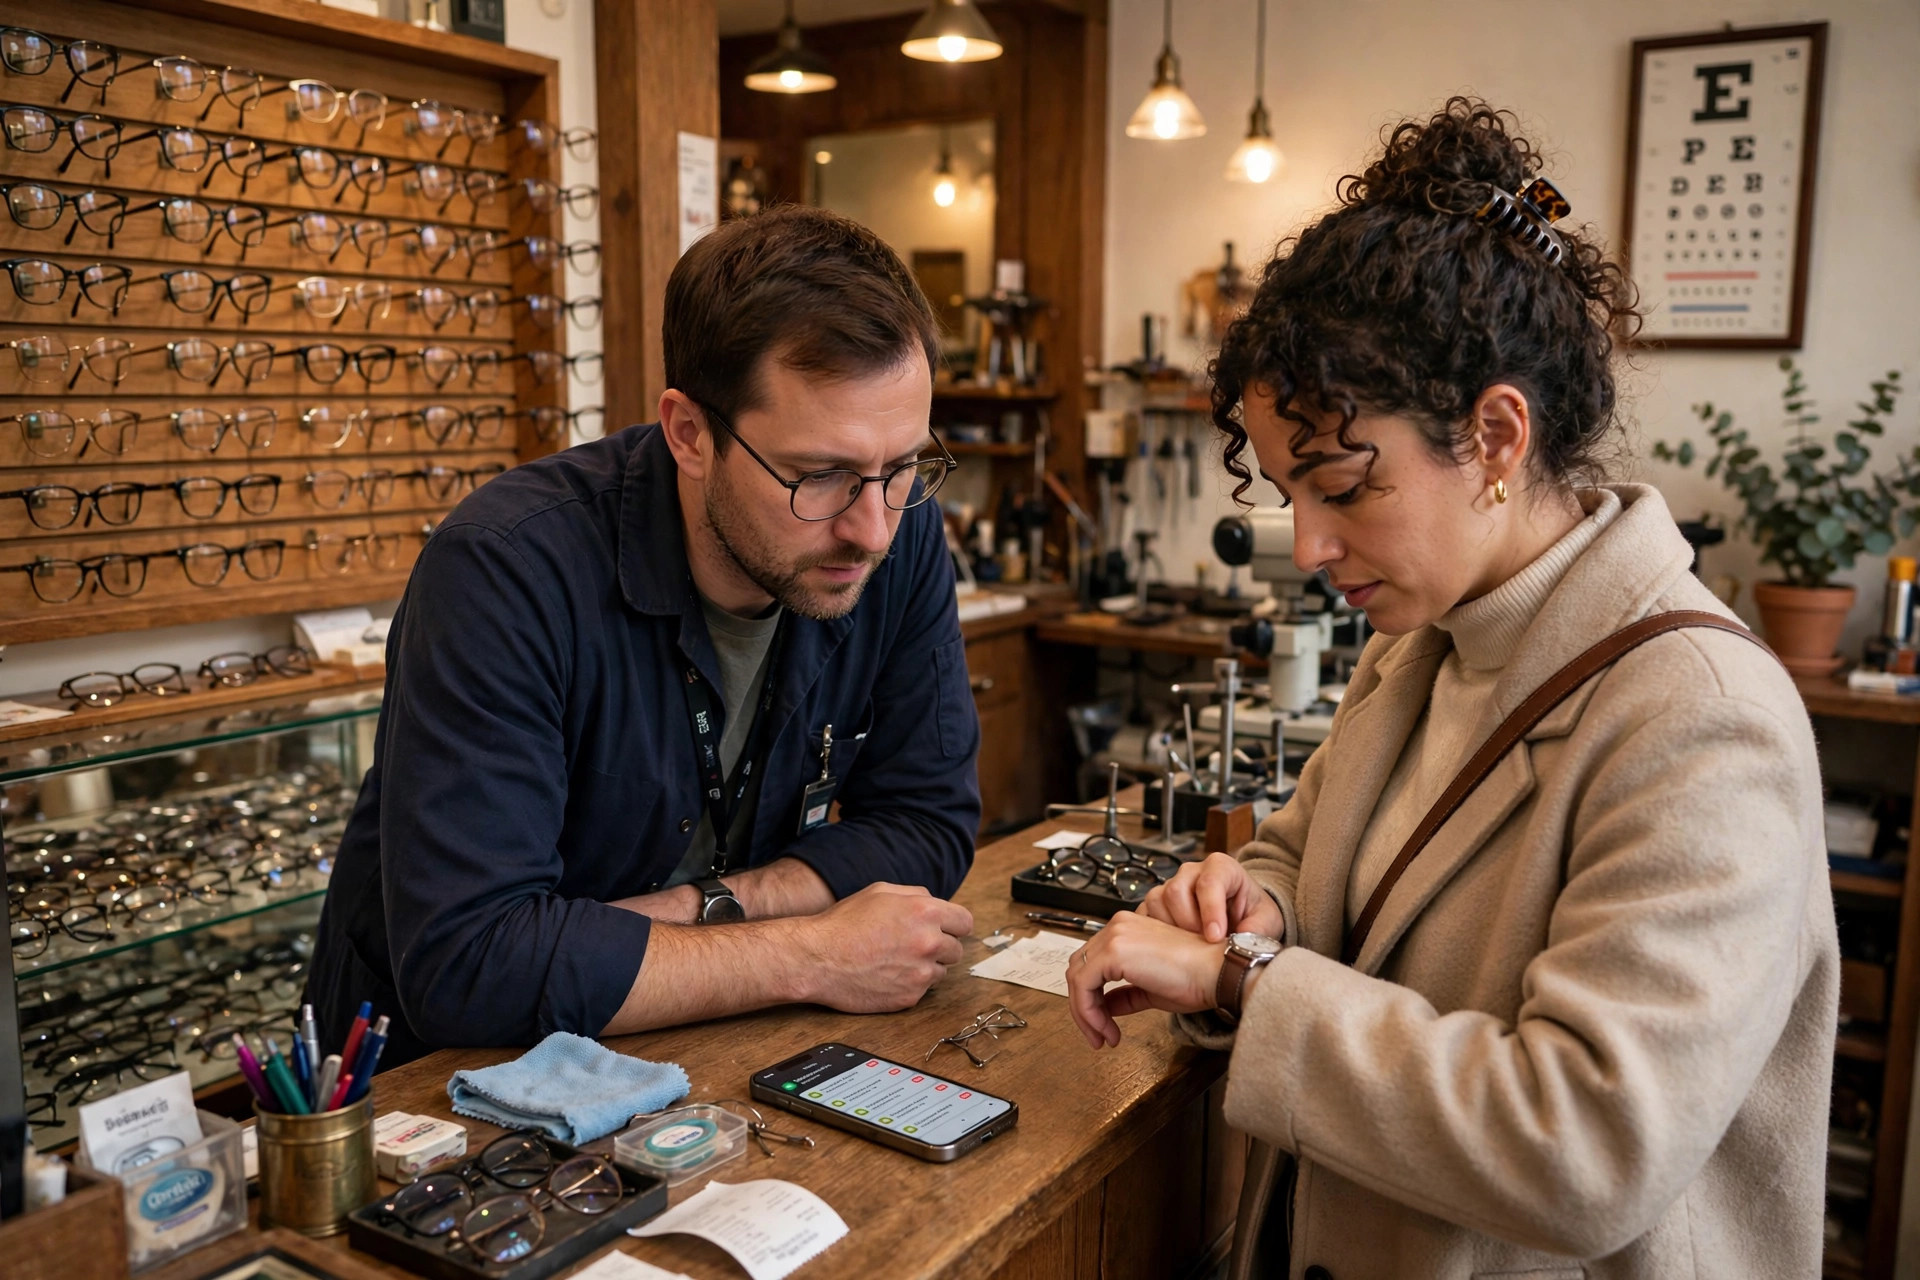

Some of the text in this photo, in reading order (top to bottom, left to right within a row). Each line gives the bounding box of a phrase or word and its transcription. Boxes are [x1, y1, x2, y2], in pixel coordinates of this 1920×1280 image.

[1692, 61, 1753, 123] E
[1682, 135, 1755, 164] P E
